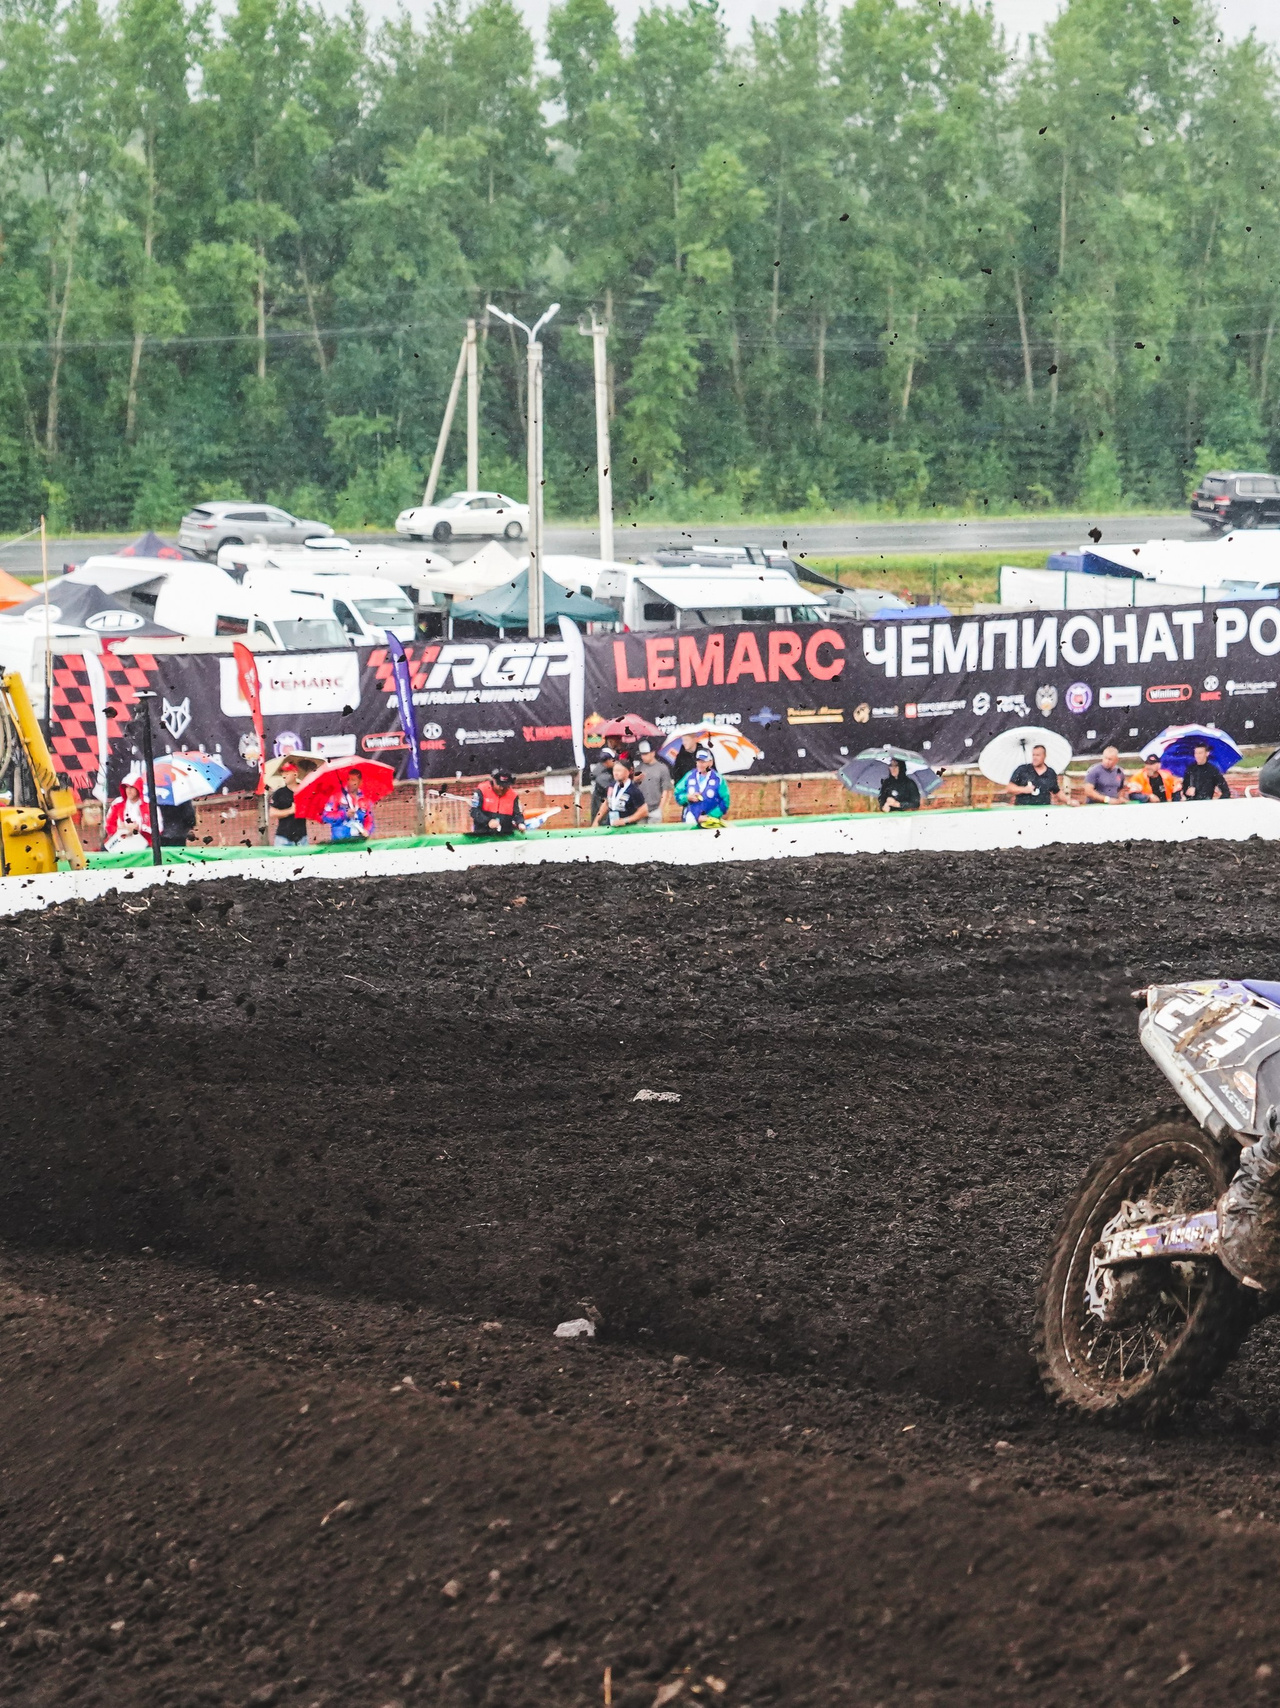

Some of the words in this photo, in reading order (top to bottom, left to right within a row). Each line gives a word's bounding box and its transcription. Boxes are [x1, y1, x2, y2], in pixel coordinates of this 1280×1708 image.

[424, 641, 573, 689] RGP
[612, 629, 847, 693] LEMARC
[863, 610, 1203, 678] ЧЕМПИОНАТ
[269, 676, 344, 692] LEMARC
